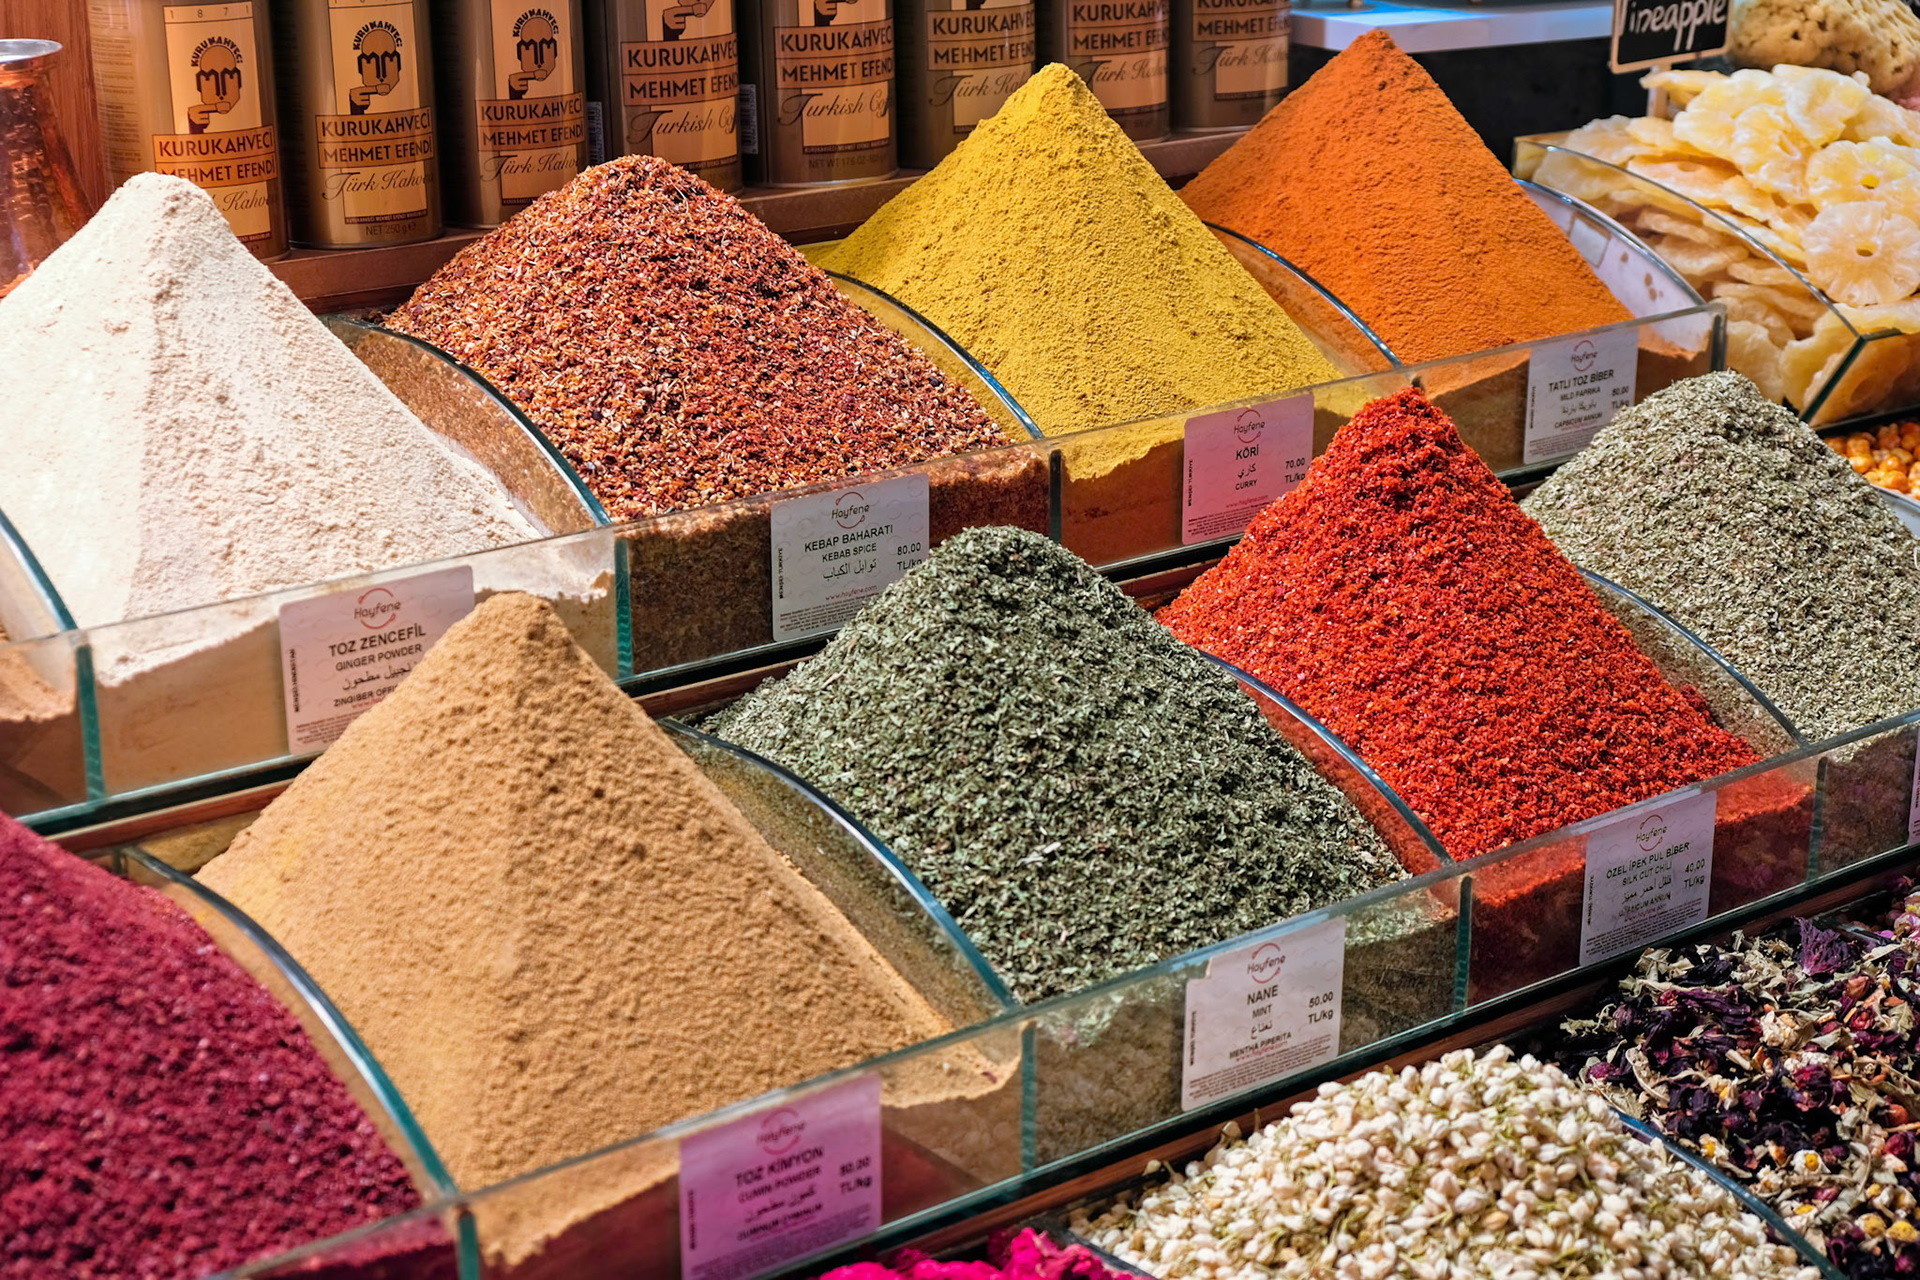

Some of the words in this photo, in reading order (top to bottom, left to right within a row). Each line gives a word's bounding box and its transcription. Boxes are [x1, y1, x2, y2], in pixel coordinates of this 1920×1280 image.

[1198, 17, 1263, 36] MEHMET
[1073, 31, 1142, 50] MEHMET
[934, 44, 1005, 64] MEHMET
[782, 62, 857, 82] MEHMET
[630, 78, 706, 99] MEHMET
[929, 74, 990, 107] Türk
[777, 92, 864, 126] Turkish
[322, 109, 430, 137] KURUKAHVECİ
[627, 108, 714, 144] Turkish
[159, 127, 273, 157] KURUKAHVECİ
[482, 129, 546, 146] MEHMET
[324, 145, 390, 162] MEHMET
[396, 136, 432, 159] EFENDİ
[238, 155, 275, 179] EFENDİ
[480, 153, 535, 181] Türk
[322, 172, 380, 200] Türk
[1549, 379, 1571, 392] TATLI
[1573, 375, 1588, 387] TOZ
[1590, 369, 1614, 383] BİBER
[1234, 421, 1265, 434] Hayfene
[1235, 443, 1259, 460] KÖRİ
[1285, 457, 1306, 470] 70.00
[1235, 479, 1258, 490] CURRY
[831, 504, 870, 520] Hayfene
[804, 536, 839, 552] KEBAP
[842, 524, 893, 544] BAHARATI
[822, 548, 851, 562] KEBAB
[853, 542, 877, 556] SPICE
[897, 542, 921, 556] 80.00
[354, 600, 401, 619] Hayfene
[329, 640, 357, 657] TOZ
[359, 623, 426, 650] ZENCEFİL
[335, 654, 376, 671] GINGER
[378, 643, 422, 662] POWDER
[333, 690, 374, 707] ZINGIBER
[1635, 825, 1667, 843] Hayfene
[1649, 852, 1663, 864] PUL
[1666, 842, 1690, 858] BİBER
[1640, 867, 1653, 880] CUT
[1684, 858, 1705, 873] 40.00
[1683, 875, 1705, 889] TL/kg
[1247, 954, 1286, 975] Hayfene
[1247, 985, 1278, 1006] NANE
[1308, 991, 1334, 1008] 50.00
[1252, 1003, 1272, 1019] MINT
[1308, 1009, 1334, 1025] TL/kg
[736, 1166, 764, 1187] TOZ
